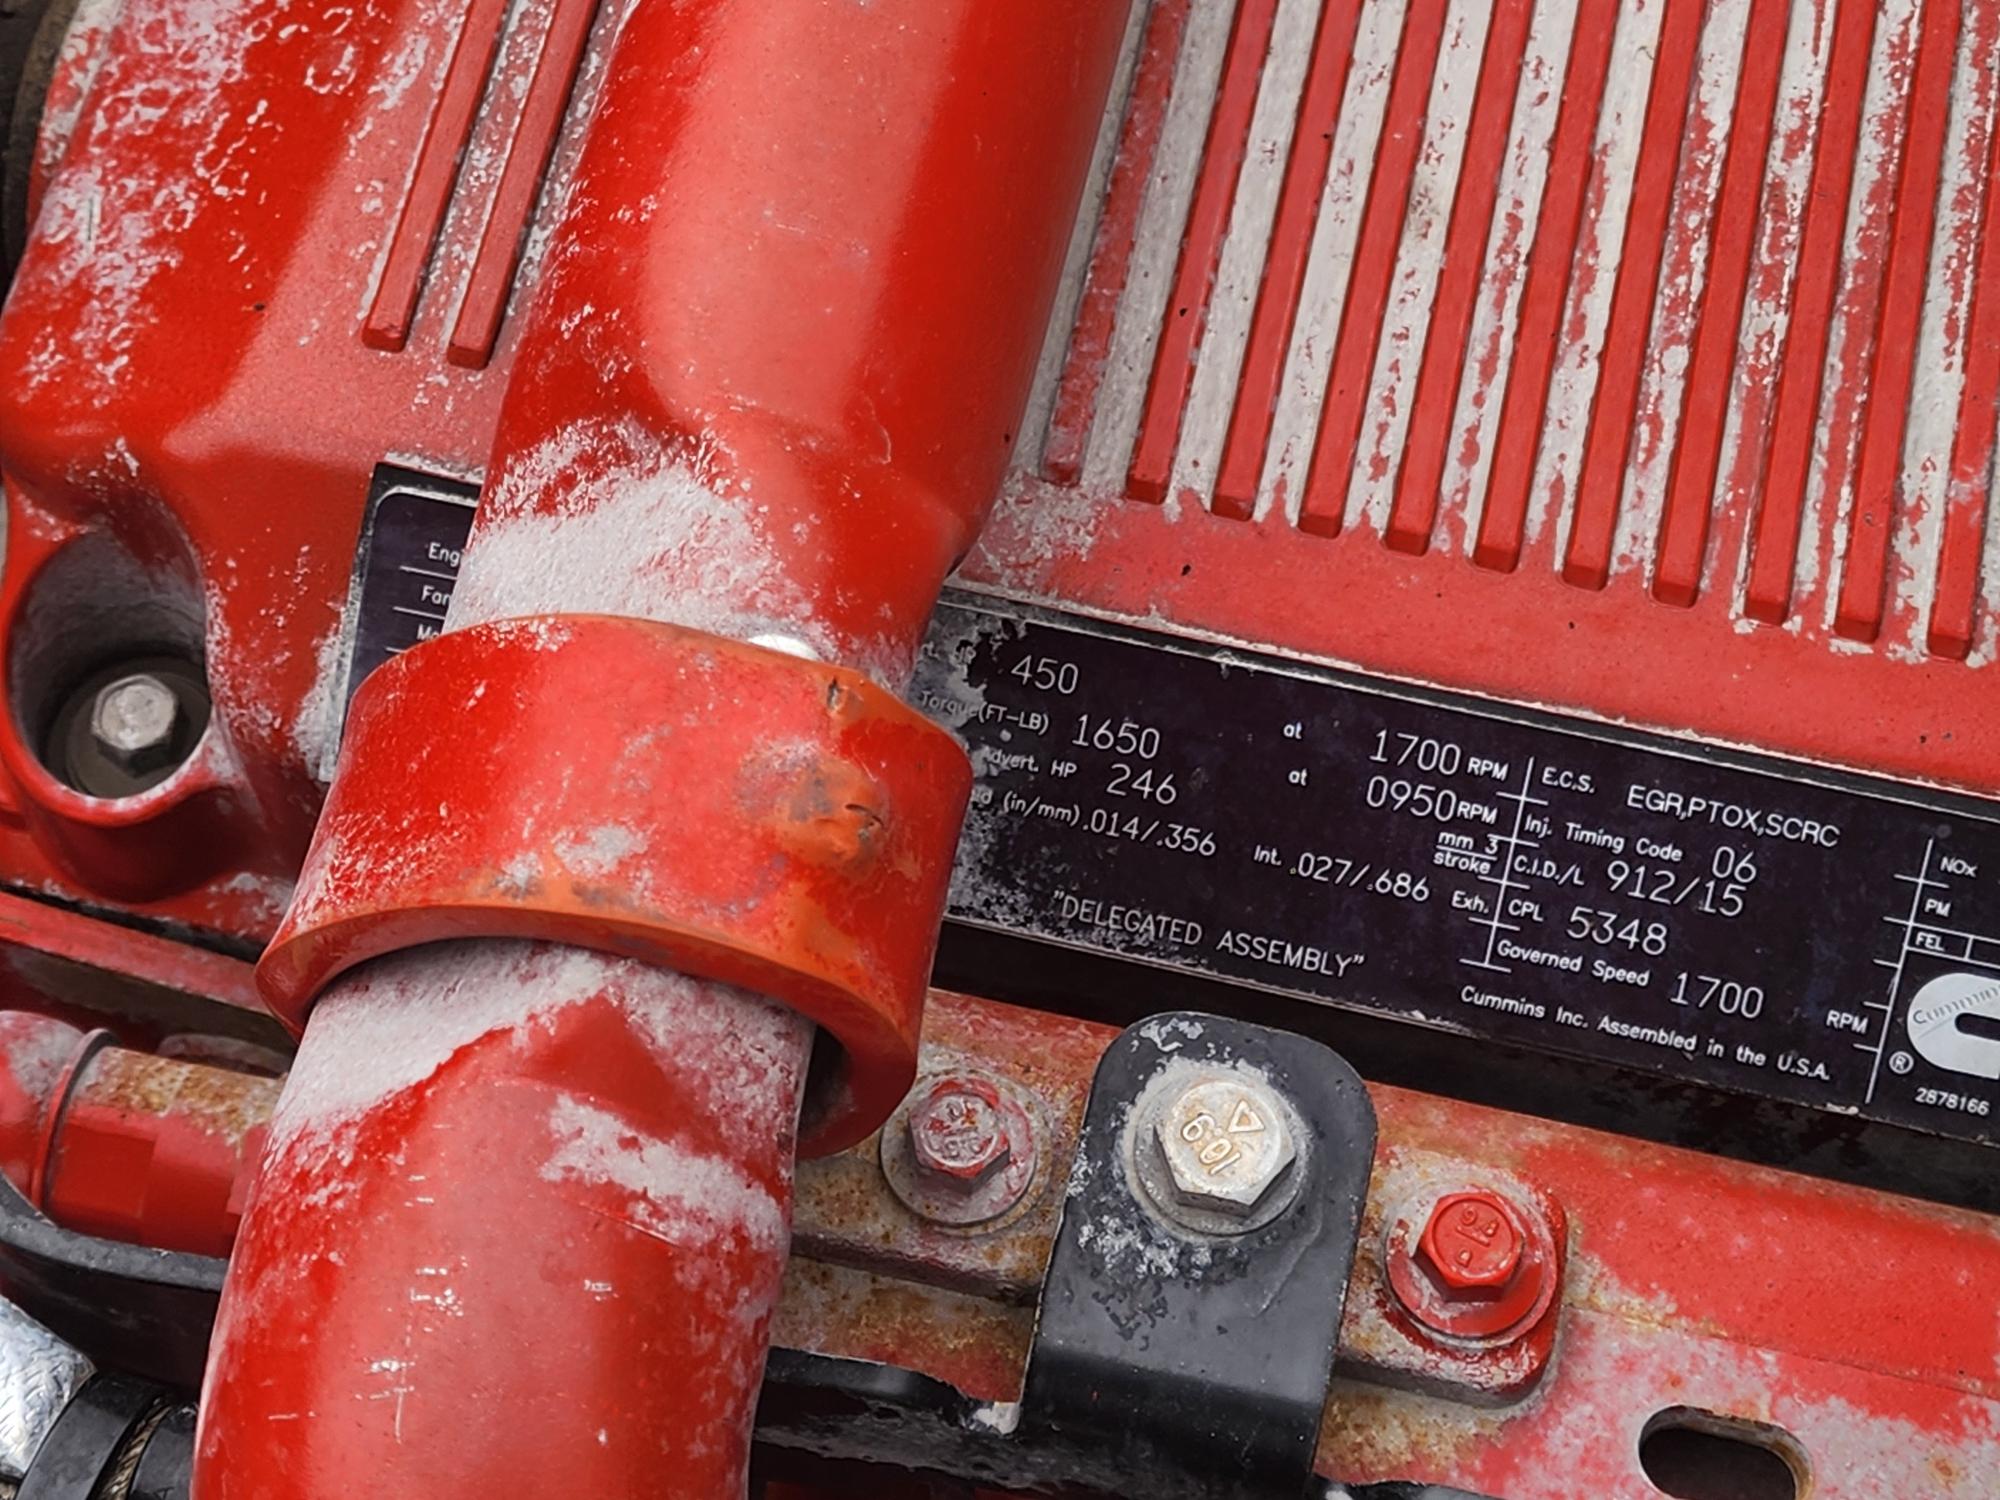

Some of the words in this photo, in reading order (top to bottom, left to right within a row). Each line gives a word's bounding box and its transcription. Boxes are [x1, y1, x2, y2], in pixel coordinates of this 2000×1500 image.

[428, 542, 463, 567] Eng
[1011, 655, 1079, 694] 450
[1283, 722, 1302, 739] at
[1369, 729, 1461, 775] 1700
[1466, 757, 1508, 781] RPM
[1051, 761, 1077, 777] HP
[1106, 764, 1177, 804] 246
[1072, 715, 1160, 759] 1650
[1288, 768, 1307, 786] at
[1366, 776, 1456, 822] 0950
[1457, 801, 1498, 825] RPM
[1542, 766, 1595, 793] E.C.S.
[1433, 851, 1491, 875] stroke
[1525, 814, 1552, 838] Inj.
[1565, 821, 1625, 854] Timing
[1635, 837, 1683, 862] Code
[1712, 846, 1757, 883] 06
[1254, 845, 1281, 866] Int.
[1290, 852, 1430, 901] .027/.686
[1451, 890, 1489, 913] Exh.
[1607, 860, 1747, 916] 912/15
[1508, 899, 1544, 922] CPL
[1567, 906, 1668, 956] 5348
[1924, 898, 1951, 918] PM
[1915, 932, 1946, 951] FEL
[1496, 940, 1582, 972] Governed
[1591, 959, 1650, 986] Speed
[1670, 972, 1765, 1019] 1700
[1826, 1009, 1869, 1034] RPM
[1461, 985, 1546, 1018] Cummins
[1556, 1006, 1588, 1028] Inc.
[1597, 1014, 1697, 1052] Assembled
[1707, 1038, 1724, 1057] in
[1736, 1044, 1766, 1068] the
[1777, 1054, 1831, 1081] U.S.A.
[1915, 1087, 1991, 1116] 2878166
